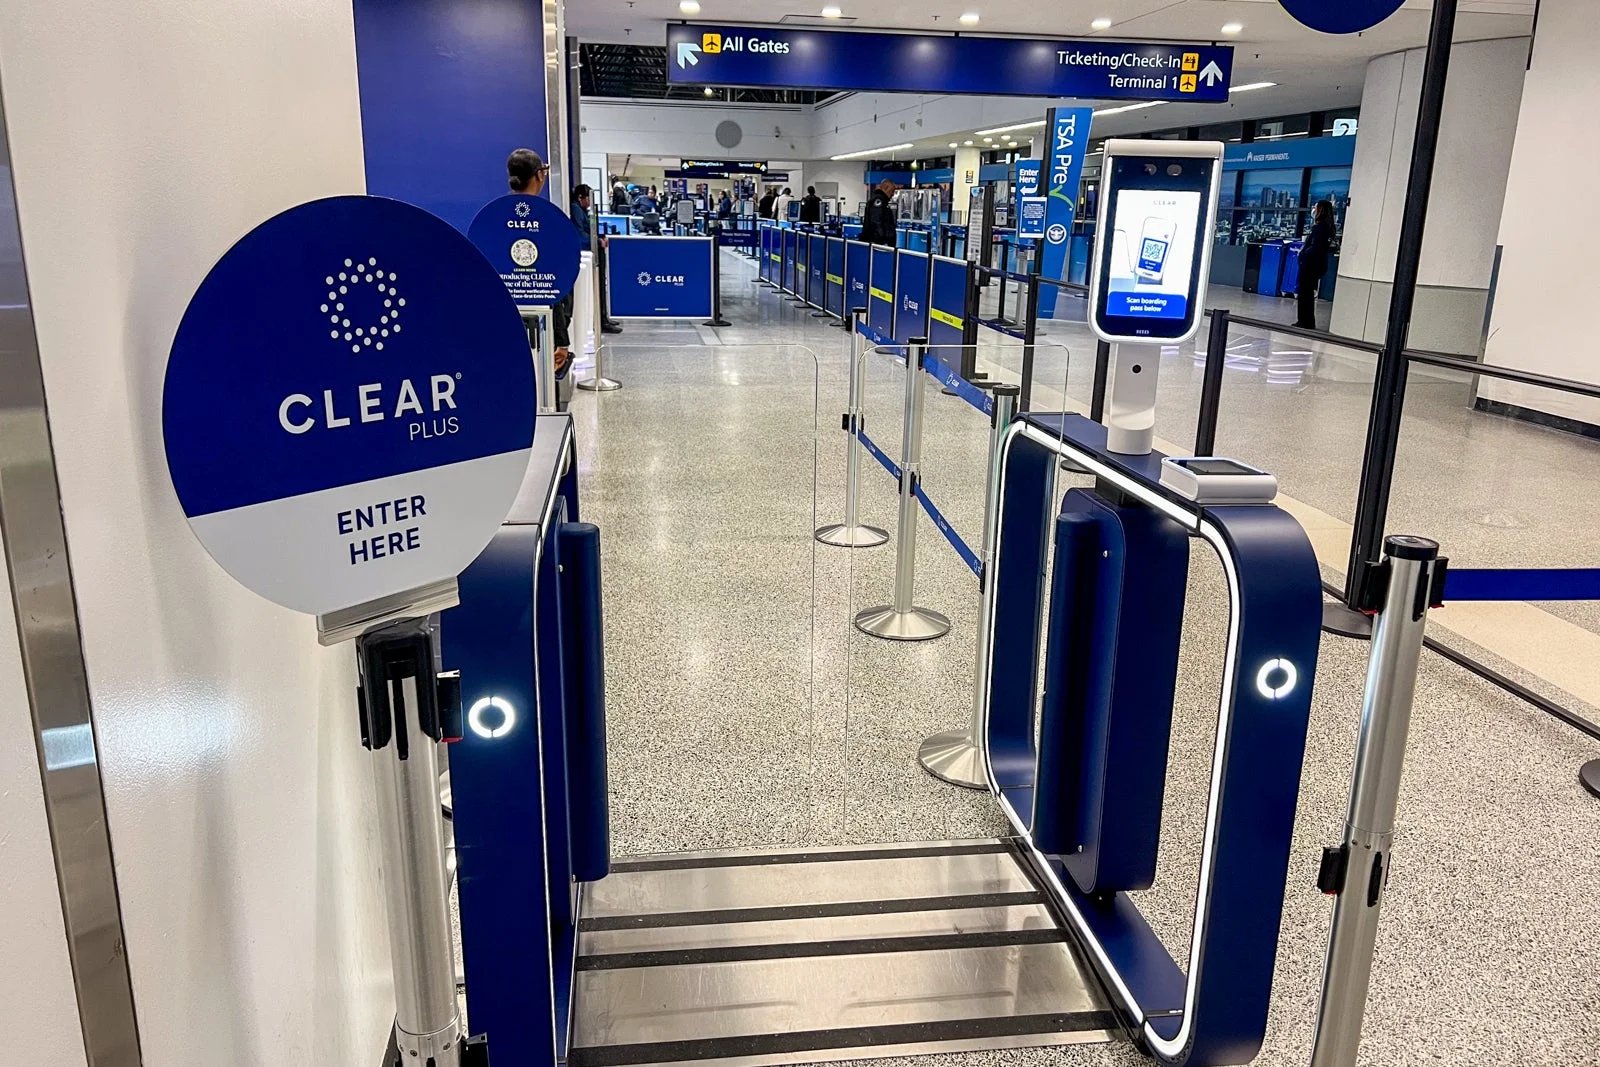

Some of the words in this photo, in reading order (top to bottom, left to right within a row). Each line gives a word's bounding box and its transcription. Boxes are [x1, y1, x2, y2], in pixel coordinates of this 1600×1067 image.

[723, 37, 743, 51] All
[748, 38, 790, 54] Gates
[1057, 51, 1181, 70] Ticketing/Check-In
[1108, 74, 1166, 89] Terminal
[1171, 77, 1178, 89] 1
[1057, 114, 1076, 150] TSA
[1053, 155, 1072, 184] Pre
[1019, 176, 1036, 184] Here
[507, 220, 539, 228] CLEAR
[500, 273, 531, 281] troducing
[654, 275, 685, 283] CLEAR
[1126, 296, 1140, 304] Scan
[1141, 297, 1168, 306] boarding
[408, 416, 460, 441] PLUS
[337, 494, 427, 535] ENTER
[349, 527, 421, 566] HERE
